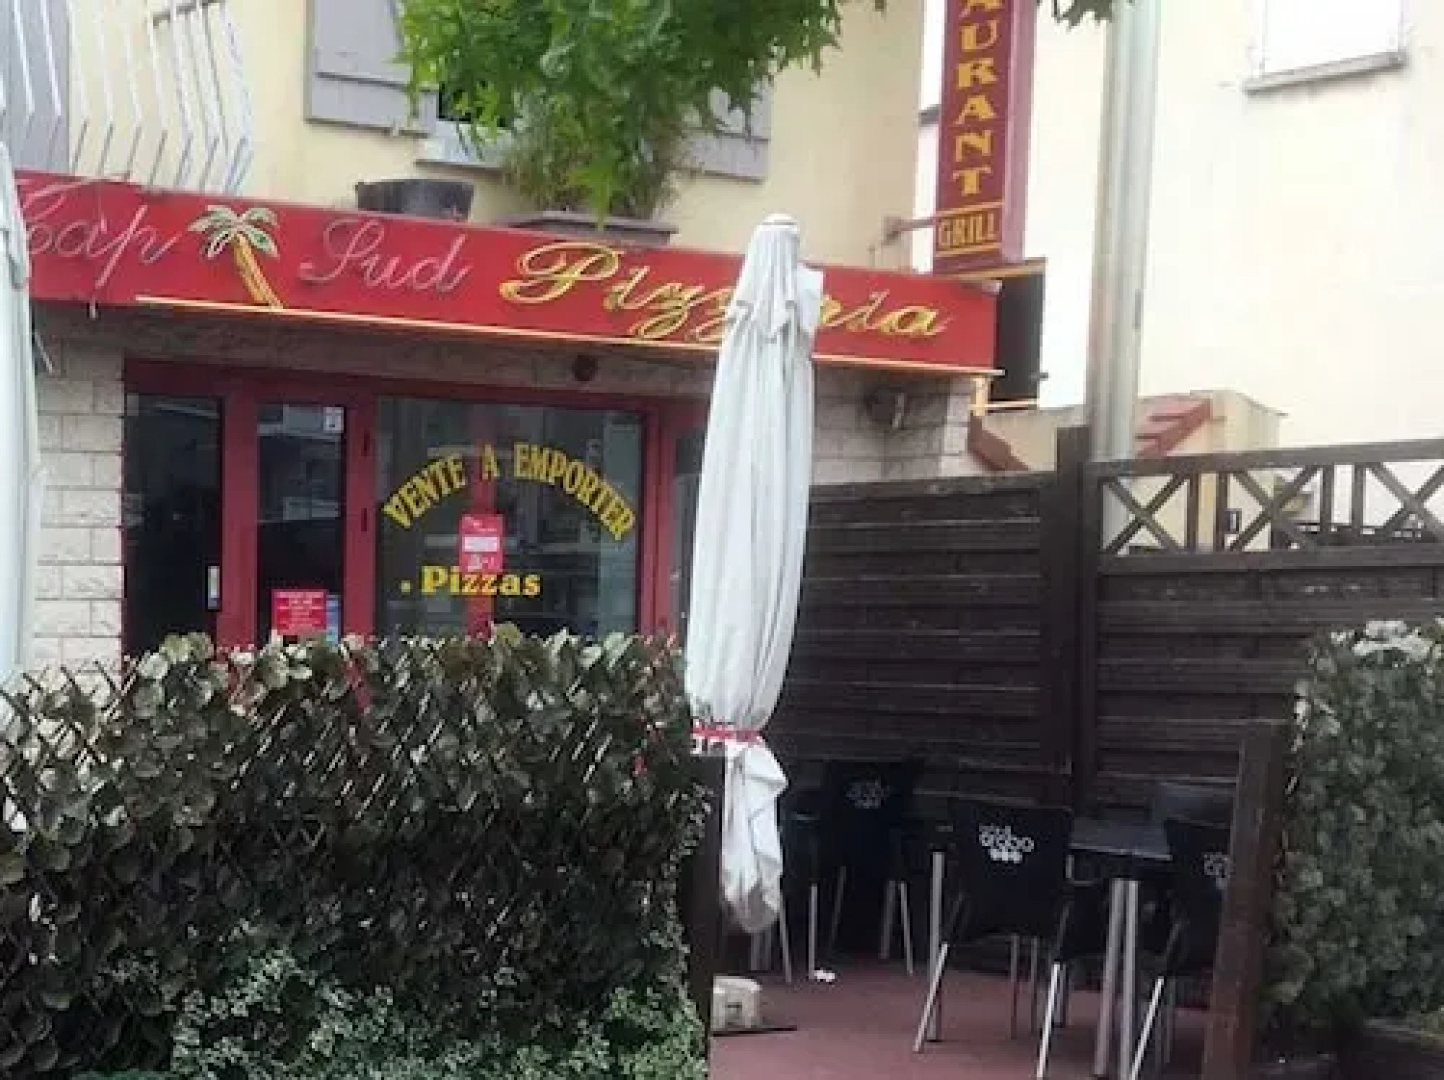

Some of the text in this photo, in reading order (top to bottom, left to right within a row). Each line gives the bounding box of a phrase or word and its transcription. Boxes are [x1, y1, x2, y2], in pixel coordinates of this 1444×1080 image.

[938, 210, 996, 249] GRILL
[299, 218, 473, 292] Sud
[500, 241, 954, 341] Pizzria
[382, 452, 466, 528] VENTE
[512, 441, 637, 541] EMPORTER
[420, 565, 542, 597] Pizzas
